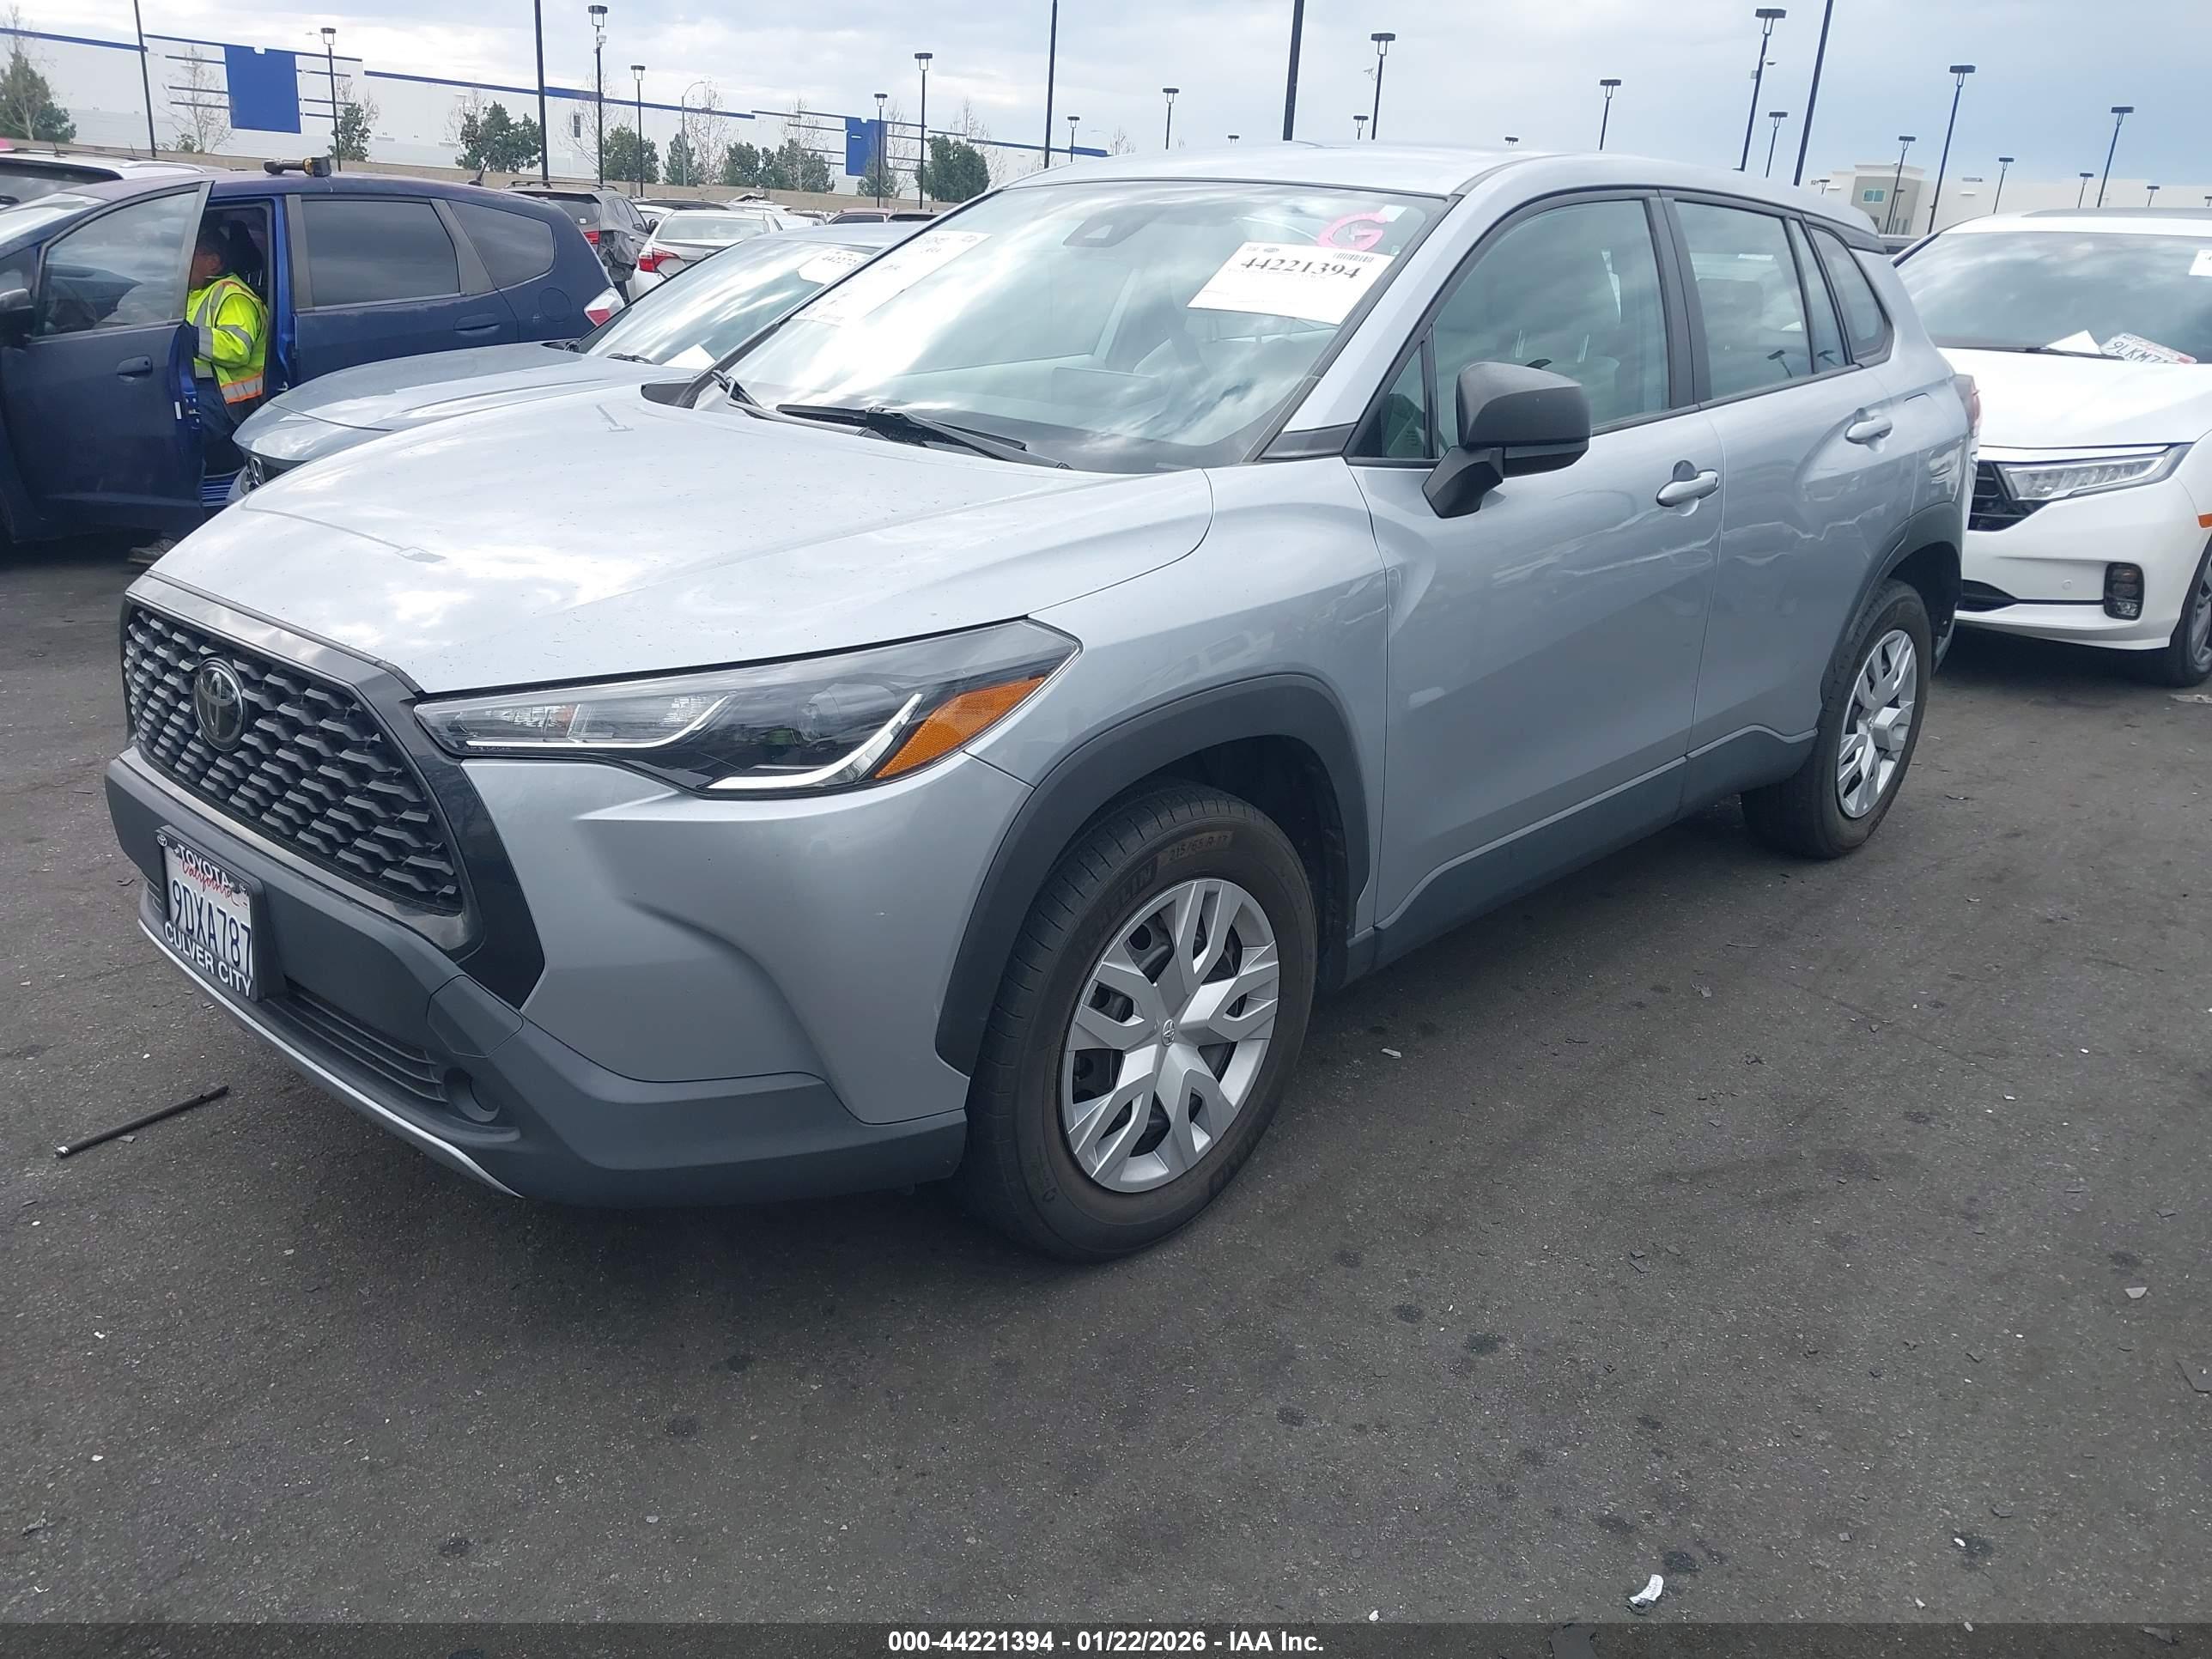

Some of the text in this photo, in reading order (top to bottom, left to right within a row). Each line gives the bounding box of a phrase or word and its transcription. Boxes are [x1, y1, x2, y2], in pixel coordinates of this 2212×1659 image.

[1241, 257, 1362, 279] 44221394
[2106, 341, 2169, 363] 9LKM7
[177, 843, 230, 889] TOYOTA
[172, 878, 252, 976] 9DXA787
[164, 921, 252, 997] CULVER CITY
